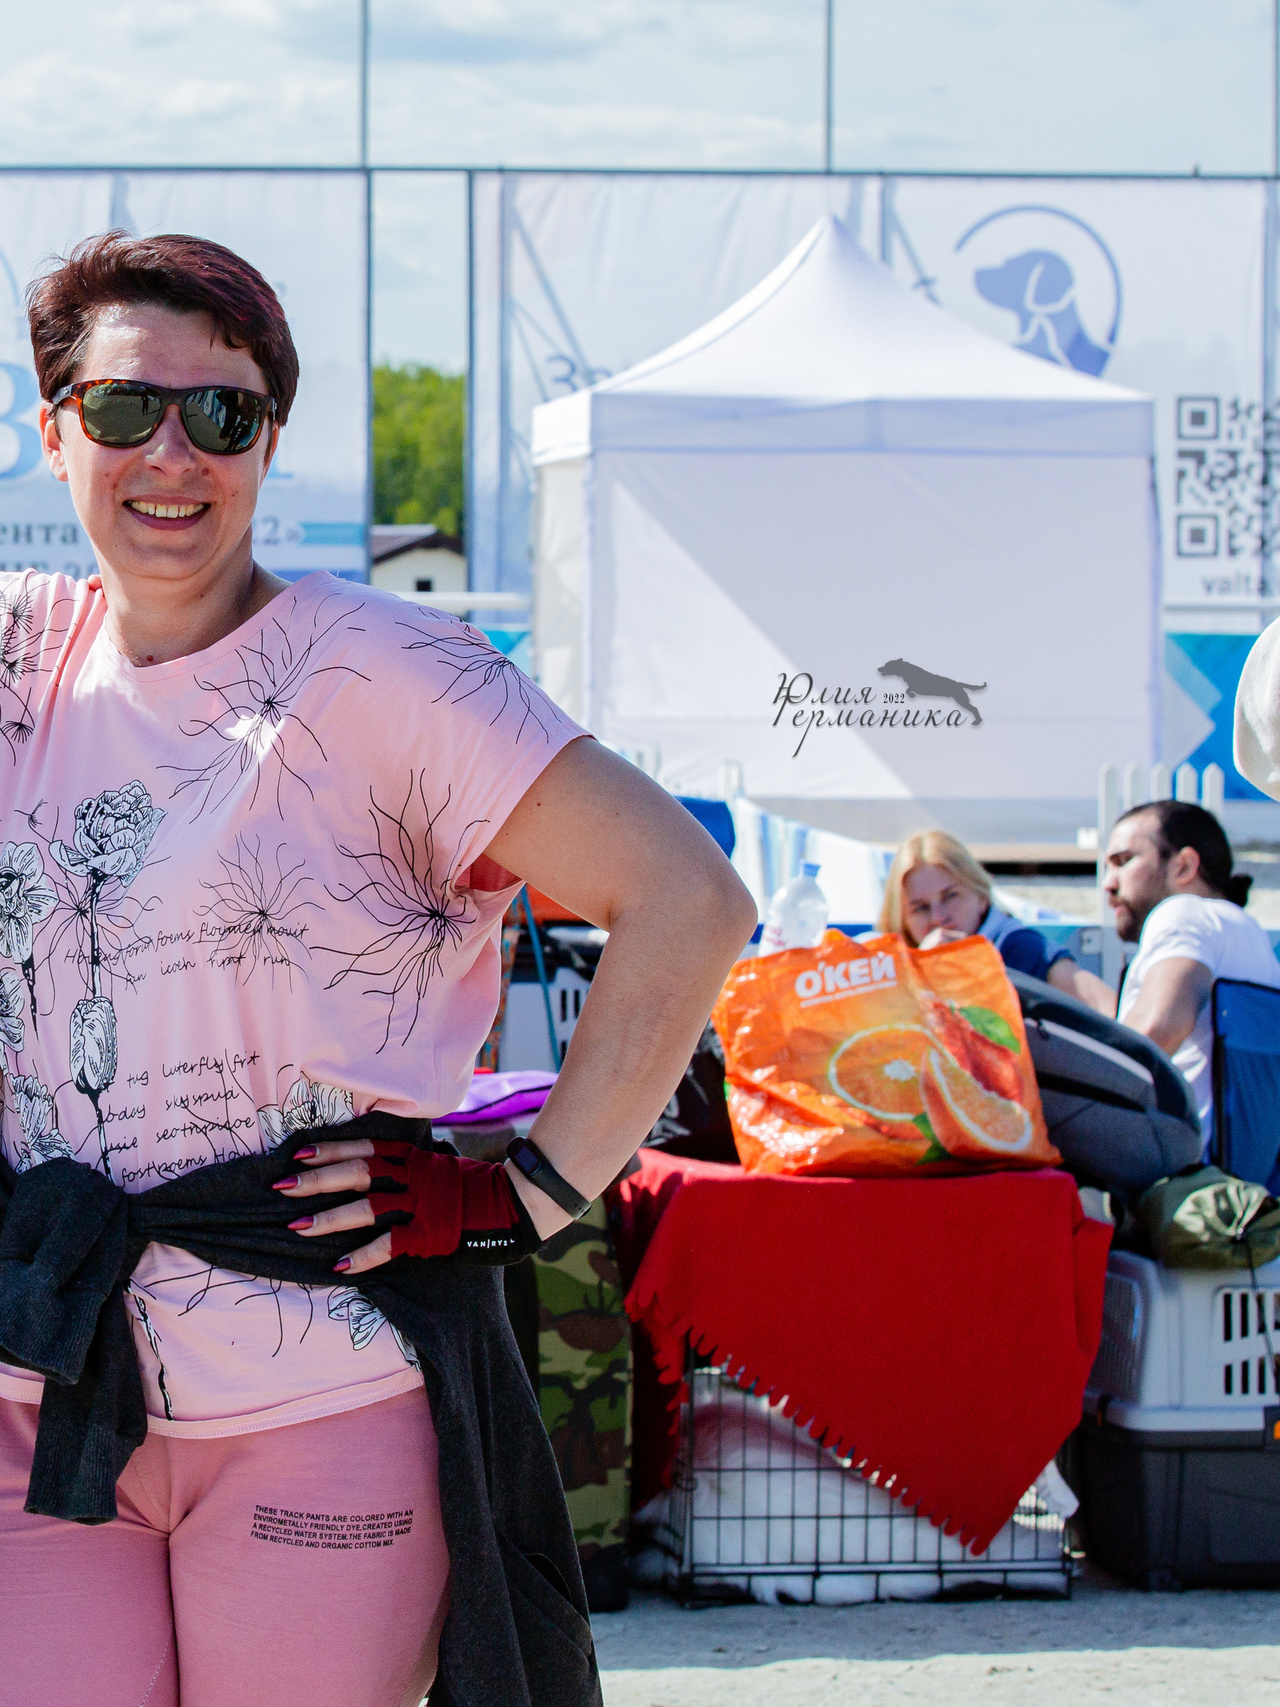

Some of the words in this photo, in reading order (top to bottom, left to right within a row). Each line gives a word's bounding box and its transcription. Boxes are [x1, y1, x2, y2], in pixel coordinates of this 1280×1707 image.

[255, 1504, 278, 1516] THESE
[280, 1510, 304, 1520] TRACK
[306, 1513, 330, 1522] PANTS
[350, 1514, 385, 1522] COLORED
[387, 1511, 404, 1519] WITH
[404, 1509, 414, 1517] AN
[258, 1524, 293, 1536] RECYCLED
[294, 1530, 318, 1539] WATER
[363, 1531, 387, 1539] FABRIC
[395, 1527, 412, 1536] MADE
[310, 1523, 345, 1531] FRIENDLY
[394, 1518, 413, 1527] USING
[250, 1531, 268, 1540] FROM
[269, 1535, 304, 1547] RECYCLED
[321, 1542, 353, 1550] ORGANIC
